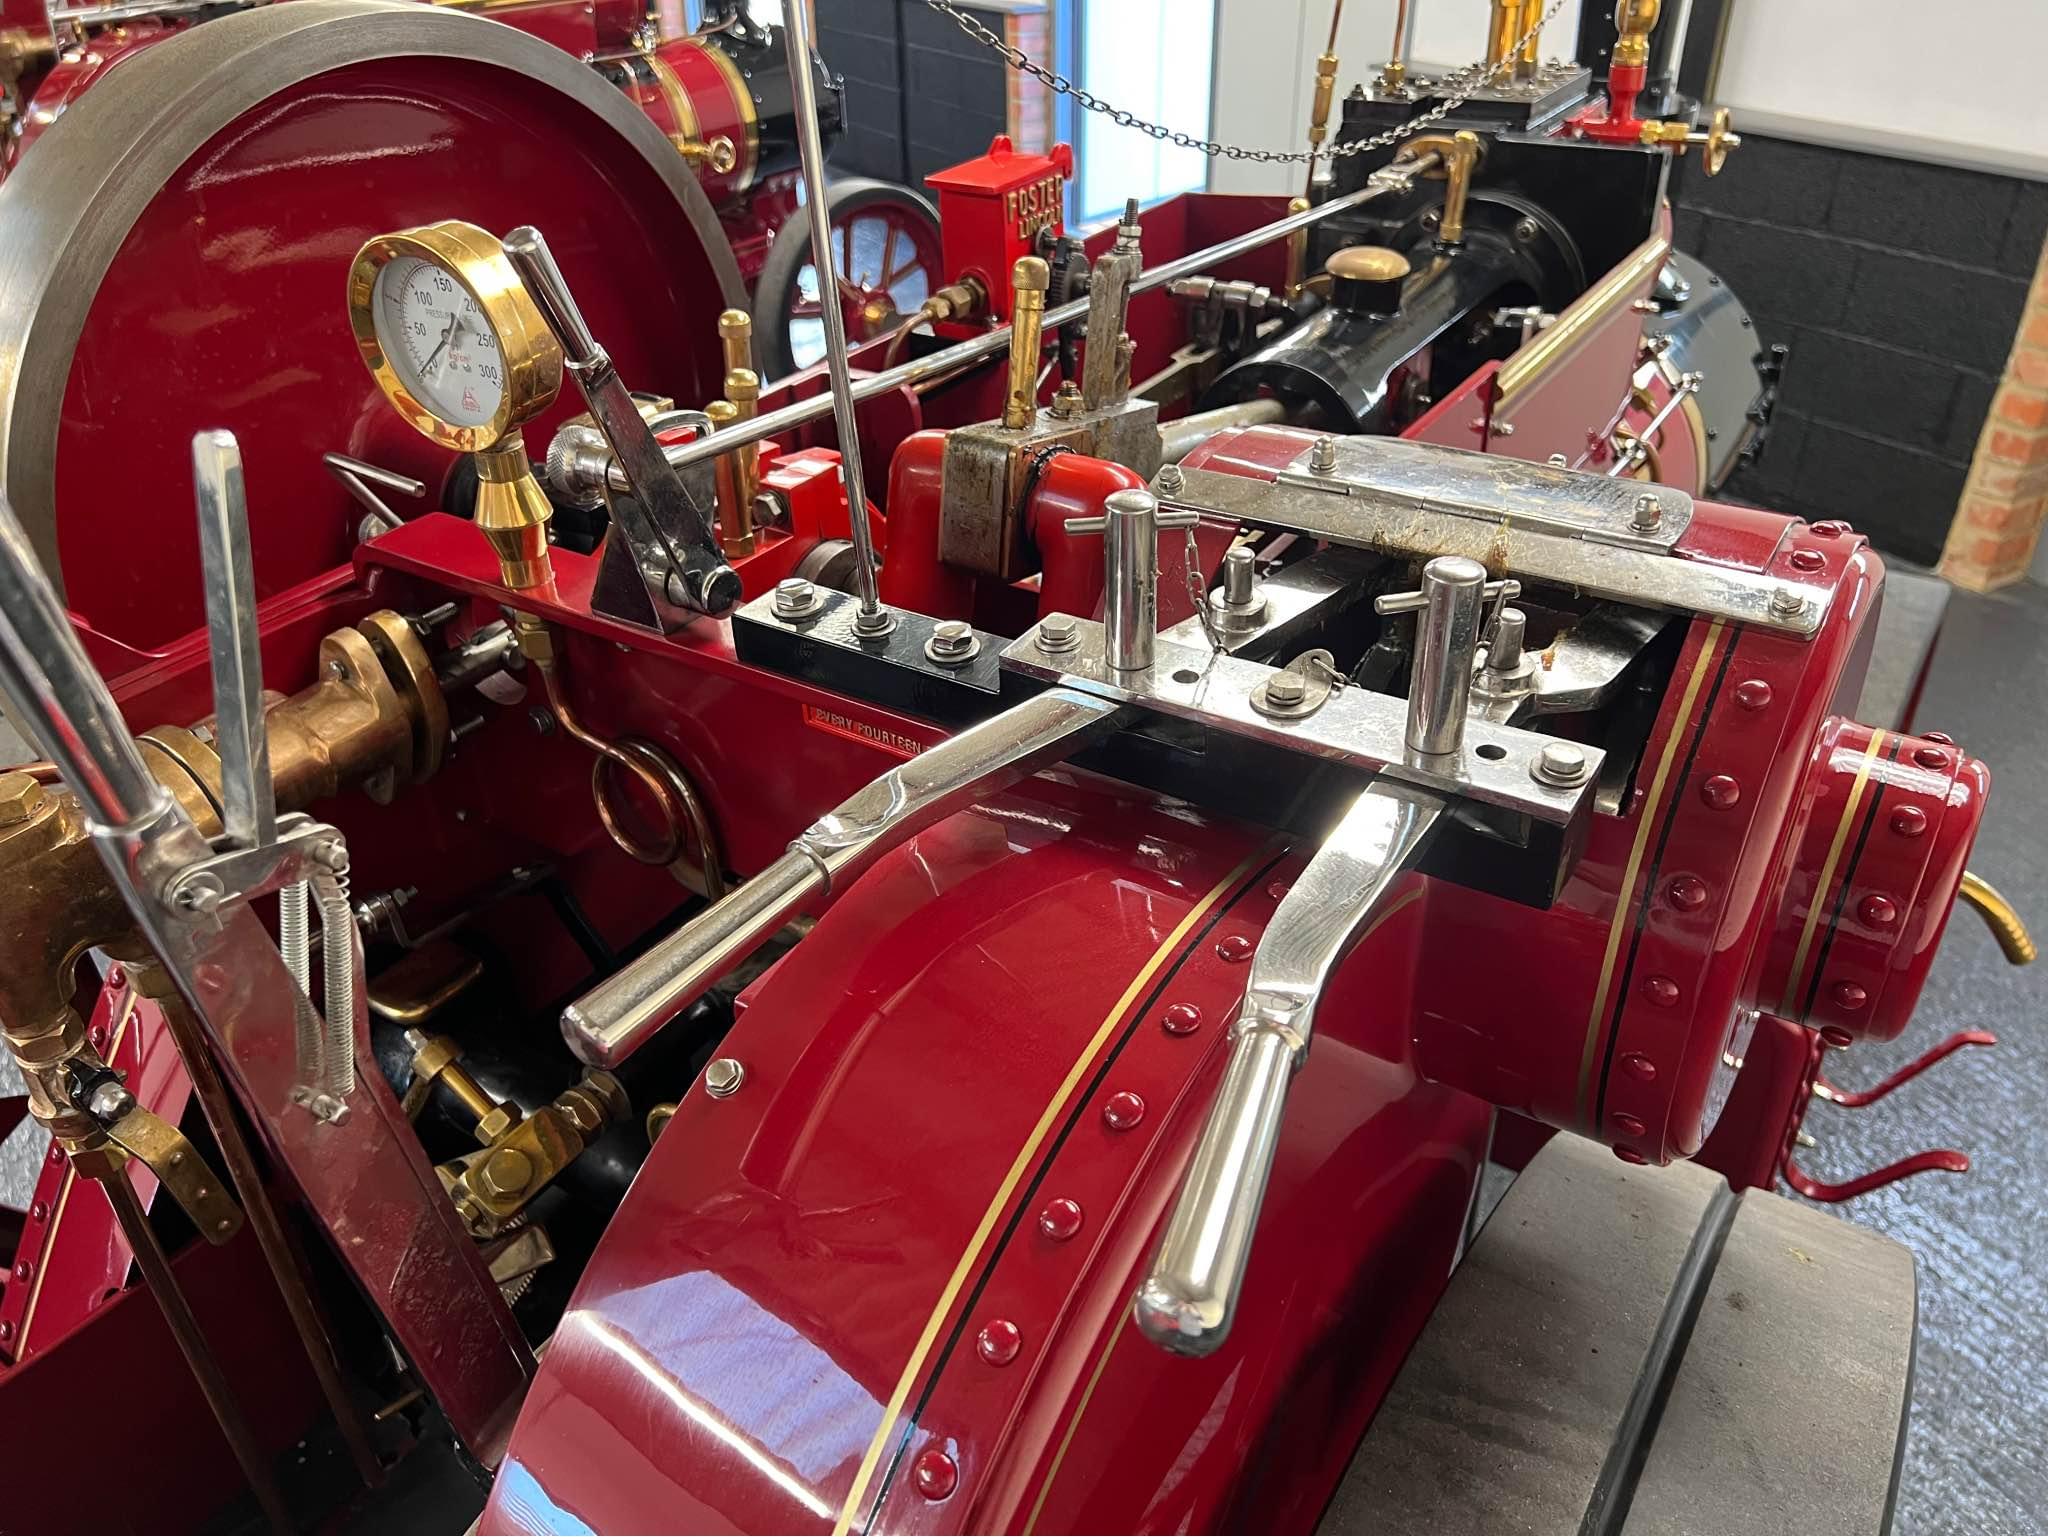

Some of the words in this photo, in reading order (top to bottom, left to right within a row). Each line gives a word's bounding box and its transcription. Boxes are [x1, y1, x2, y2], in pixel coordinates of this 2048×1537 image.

[1008, 174, 1063, 224] FOSTER
[433, 276, 452, 292] 150
[414, 290, 433, 306] 100
[414, 322, 427, 336] 50
[476, 332, 496, 348] 250
[478, 364, 498, 379] 300
[815, 708, 853, 730] EVERY
[859, 722, 921, 754] FOURTEEN
